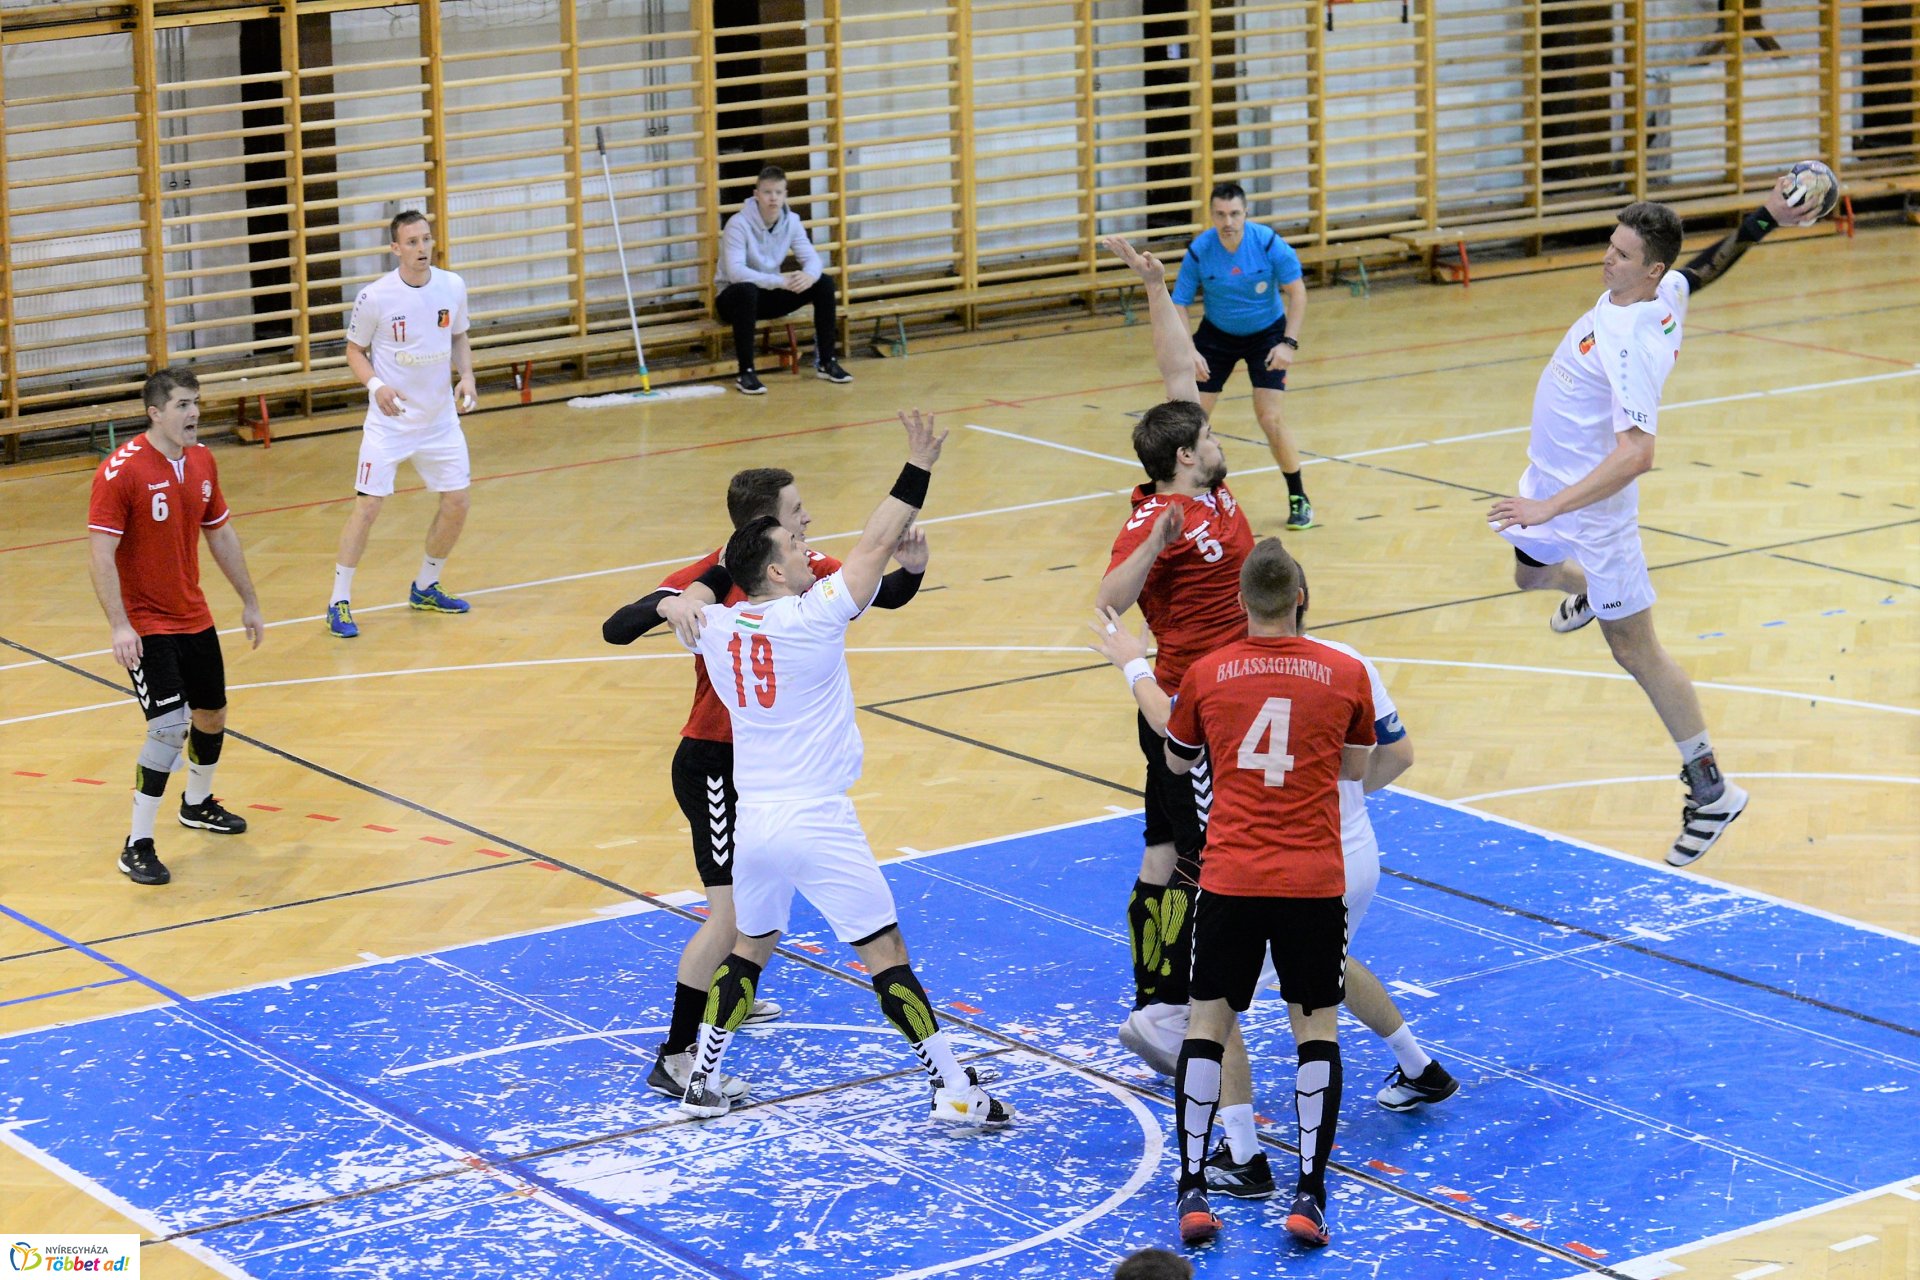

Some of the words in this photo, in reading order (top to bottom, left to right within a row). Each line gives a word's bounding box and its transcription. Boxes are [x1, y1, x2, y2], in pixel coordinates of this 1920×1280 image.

[392, 321, 405, 342] 17
[360, 461, 371, 485] 17
[152, 492, 169, 521] 6
[1195, 530, 1223, 562] 5
[1602, 601, 1622, 609] JAKO
[727, 632, 776, 709] 19
[1216, 657, 1333, 686] BALASSAGYARMAT
[1237, 697, 1294, 787] 4
